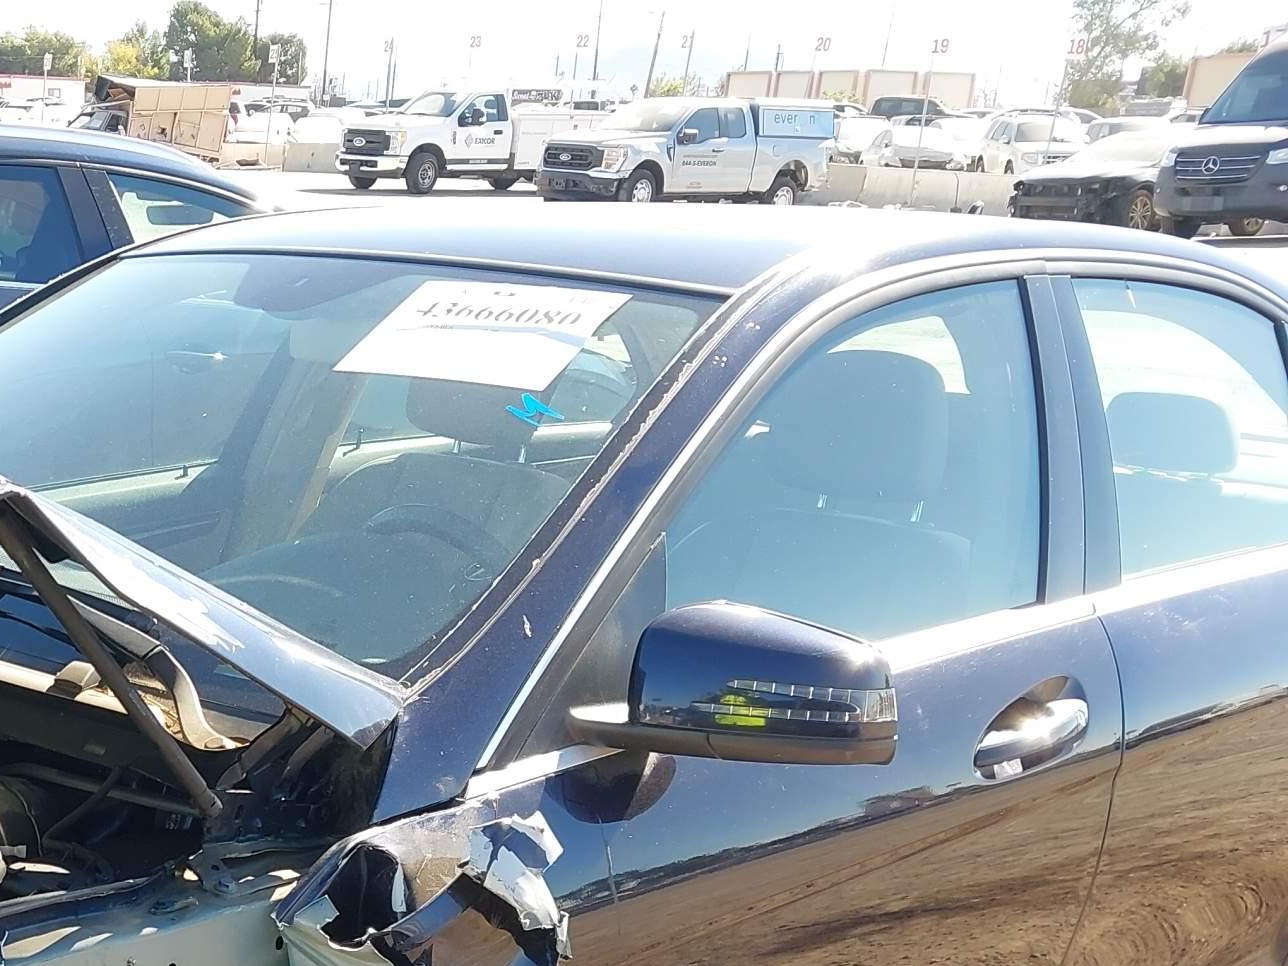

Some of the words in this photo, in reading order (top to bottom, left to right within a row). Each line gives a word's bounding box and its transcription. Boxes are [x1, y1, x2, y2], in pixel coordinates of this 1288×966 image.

[469, 35, 482, 48] 23
[576, 34, 590, 48] 22
[814, 37, 831, 52] 20
[931, 38, 950, 54] 19
[1067, 38, 1086, 55] 18
[416, 301, 583, 326] 43666080
